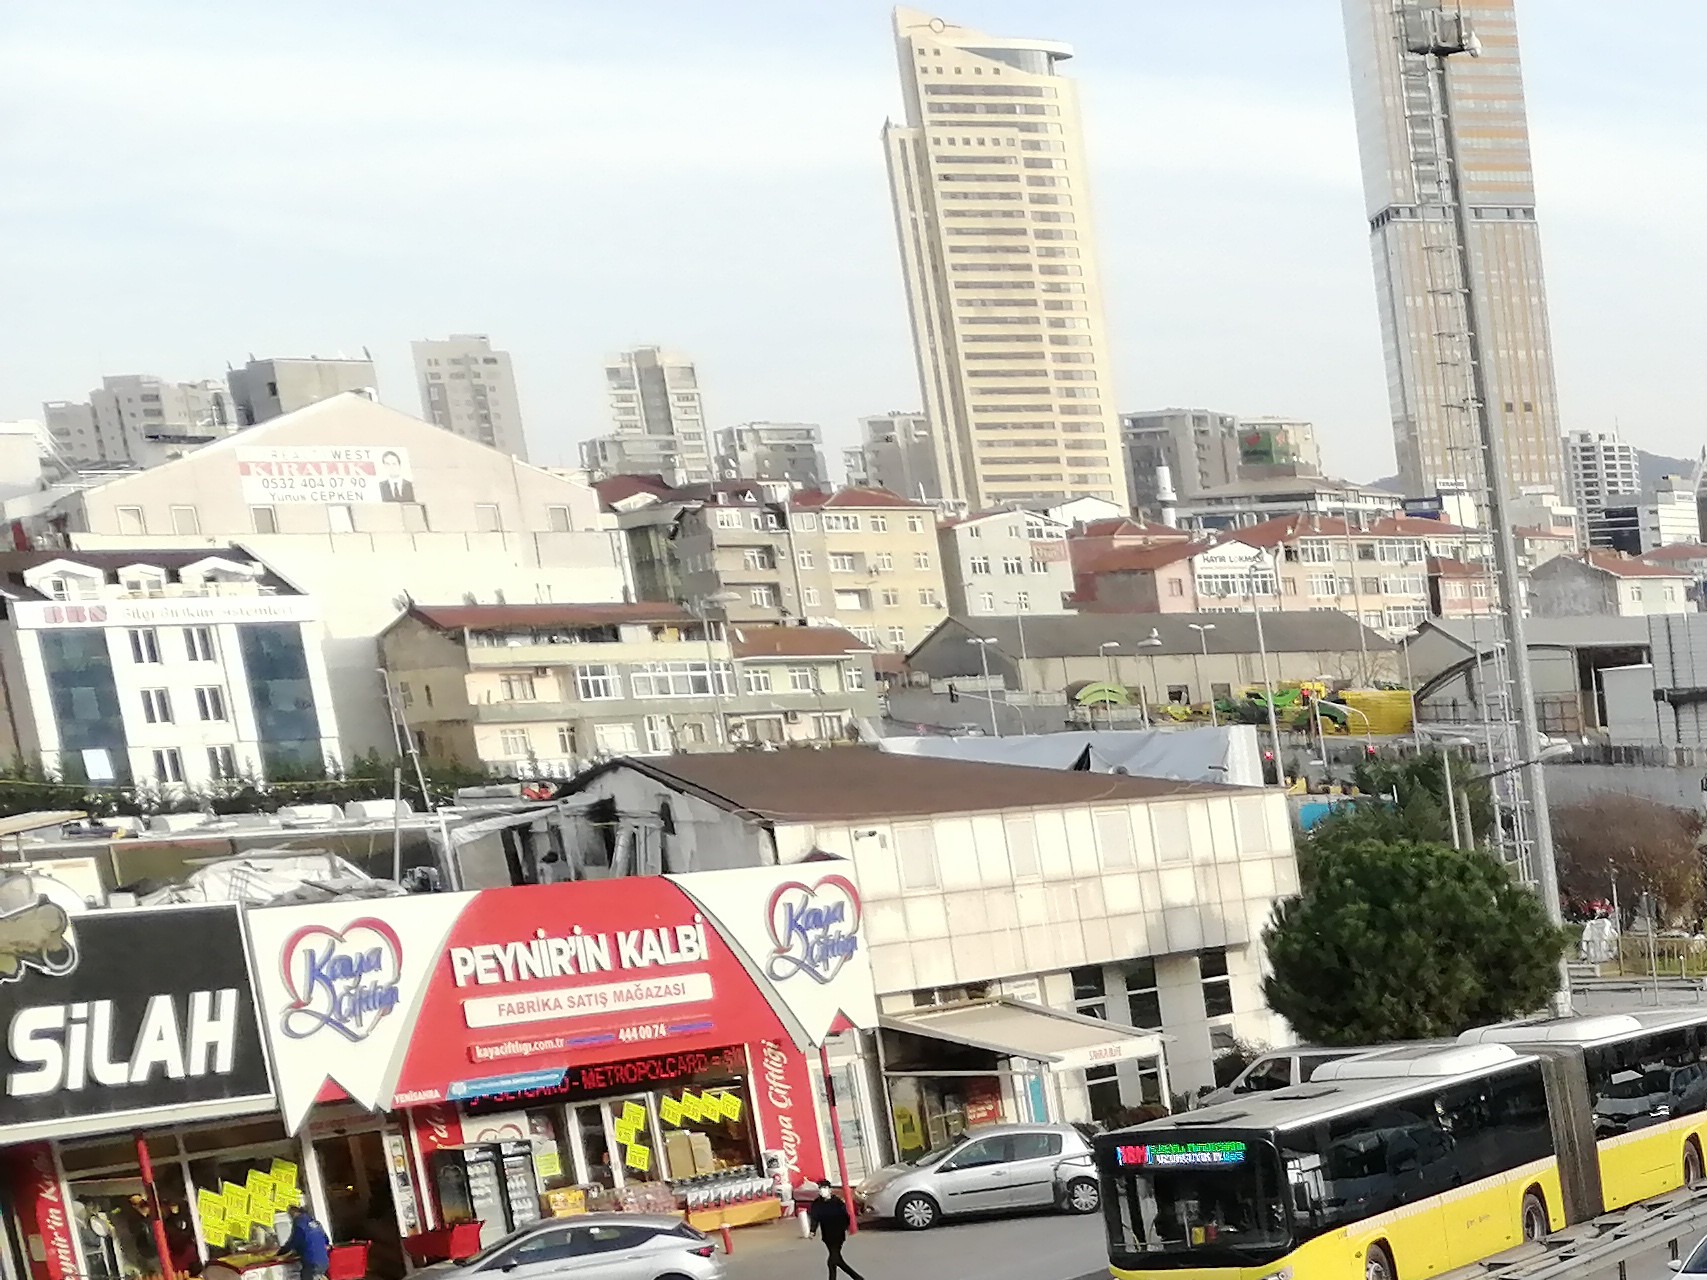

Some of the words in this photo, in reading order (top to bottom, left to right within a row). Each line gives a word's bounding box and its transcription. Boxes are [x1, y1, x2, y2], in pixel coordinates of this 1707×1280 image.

[332, 450, 371, 460] WEST
[262, 478, 295, 489] 0532
[301, 478, 325, 489] 404
[330, 478, 345, 489] 07
[350, 477, 367, 489] 90
[450, 924, 613, 988] PEYNİR'İN
[616, 912, 710, 969] KALBİ
[497, 996, 564, 1018] FABRİKA
[566, 990, 609, 1009] SATIŞ
[612, 983, 687, 1004] MAĞAZASI
